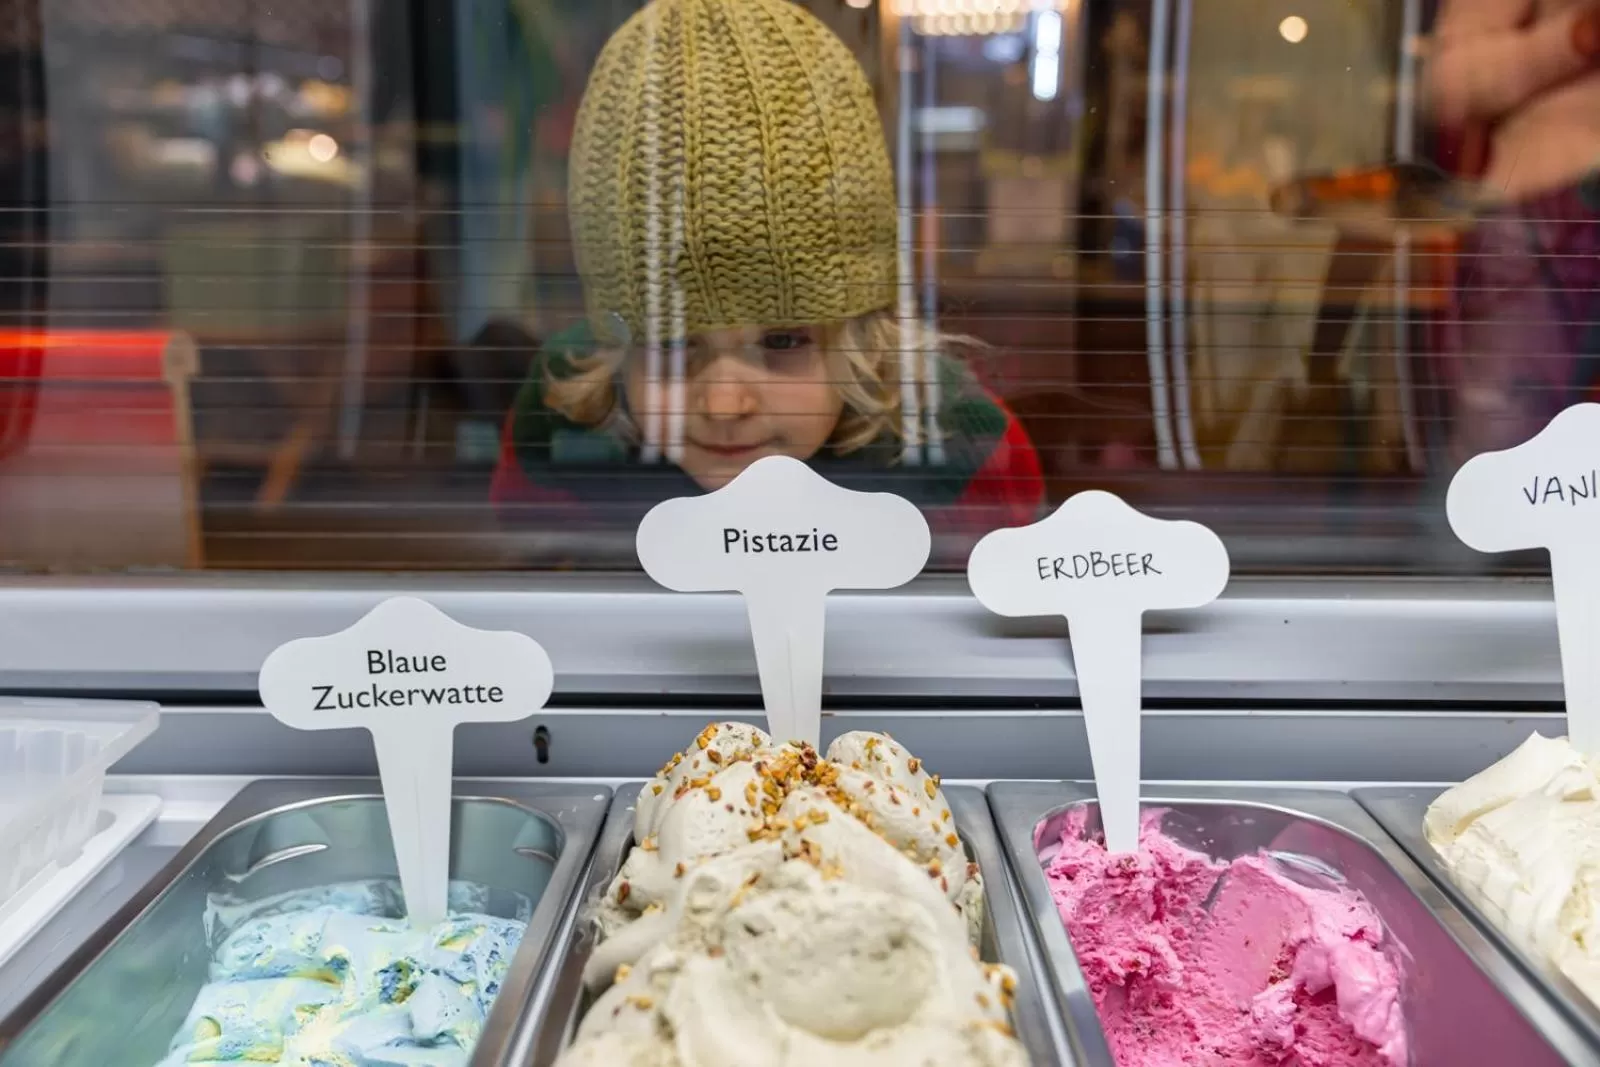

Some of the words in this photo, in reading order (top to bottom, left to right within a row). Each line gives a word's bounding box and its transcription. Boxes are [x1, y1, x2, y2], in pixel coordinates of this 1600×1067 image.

[723, 527, 838, 554] Pistazie
[1037, 551, 1162, 581] ERDBEER
[366, 649, 447, 675] Blaue
[311, 683, 504, 711] Zuckerwatte
